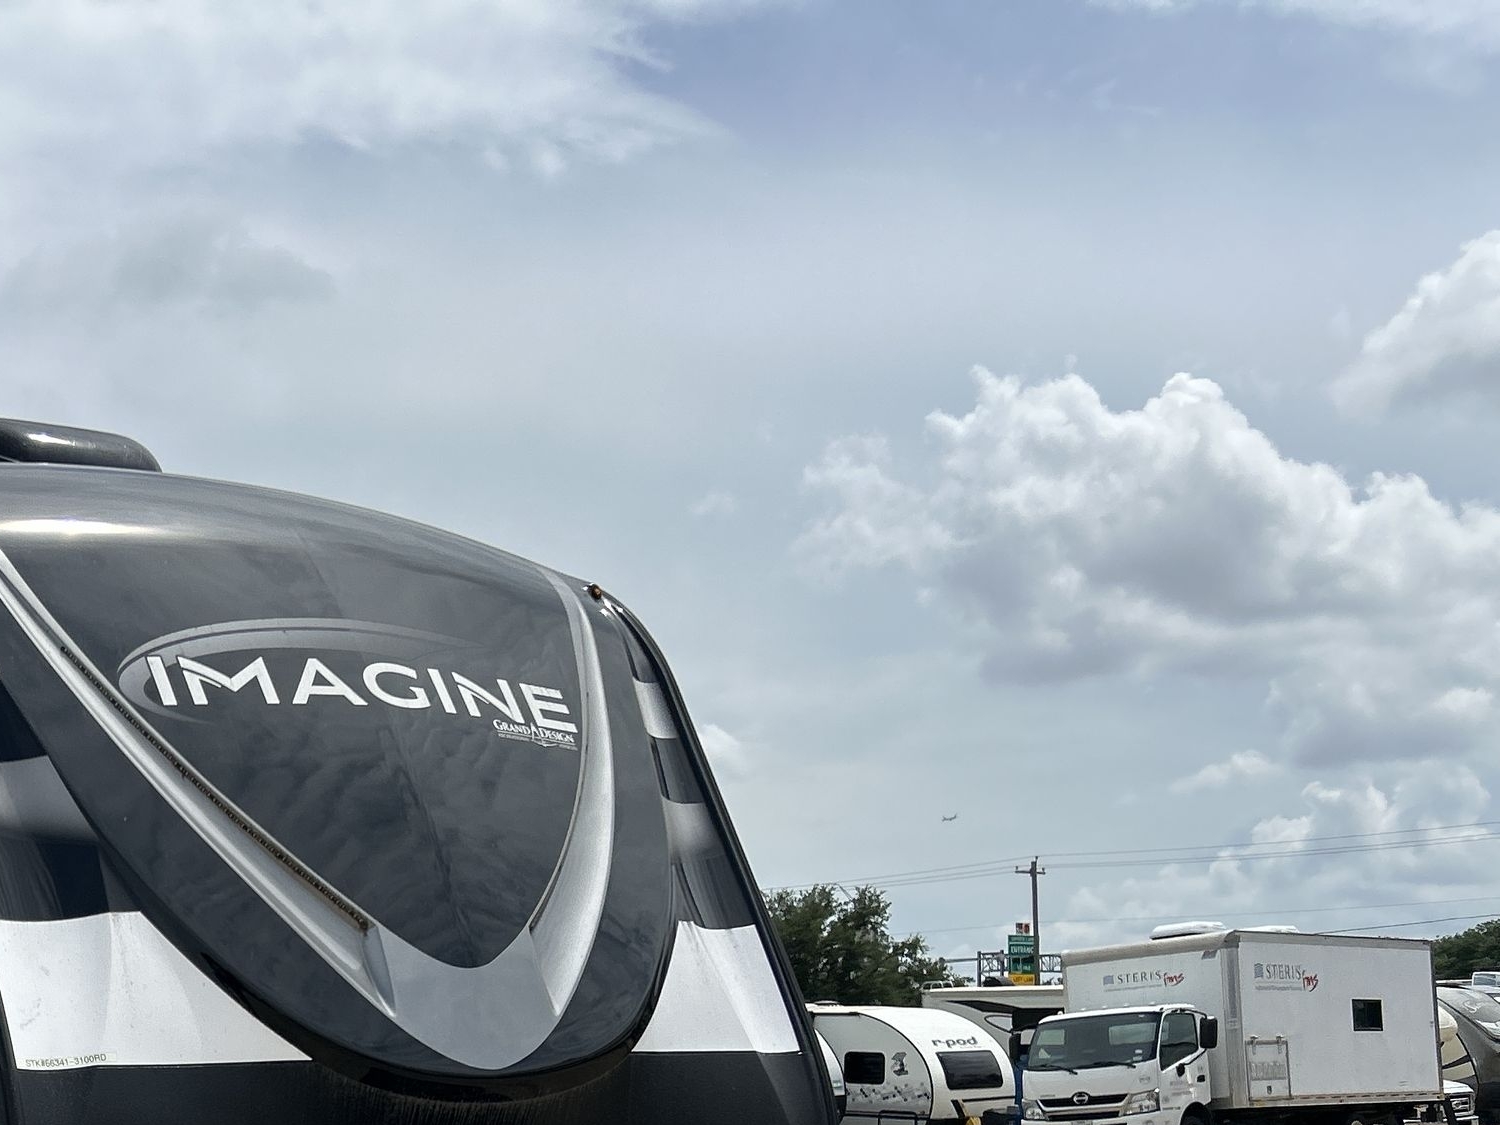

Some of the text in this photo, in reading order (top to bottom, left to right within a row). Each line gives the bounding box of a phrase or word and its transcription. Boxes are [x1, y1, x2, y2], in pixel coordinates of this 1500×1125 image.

[146, 656, 578, 733] IMAGINE
[493, 719, 531, 735] GRAND
[538, 727, 575, 743] DESIGN
[1117, 970, 1161, 984] STERIS
[1266, 964, 1302, 981] STERIS
[931, 1036, 978, 1049] r-pod
